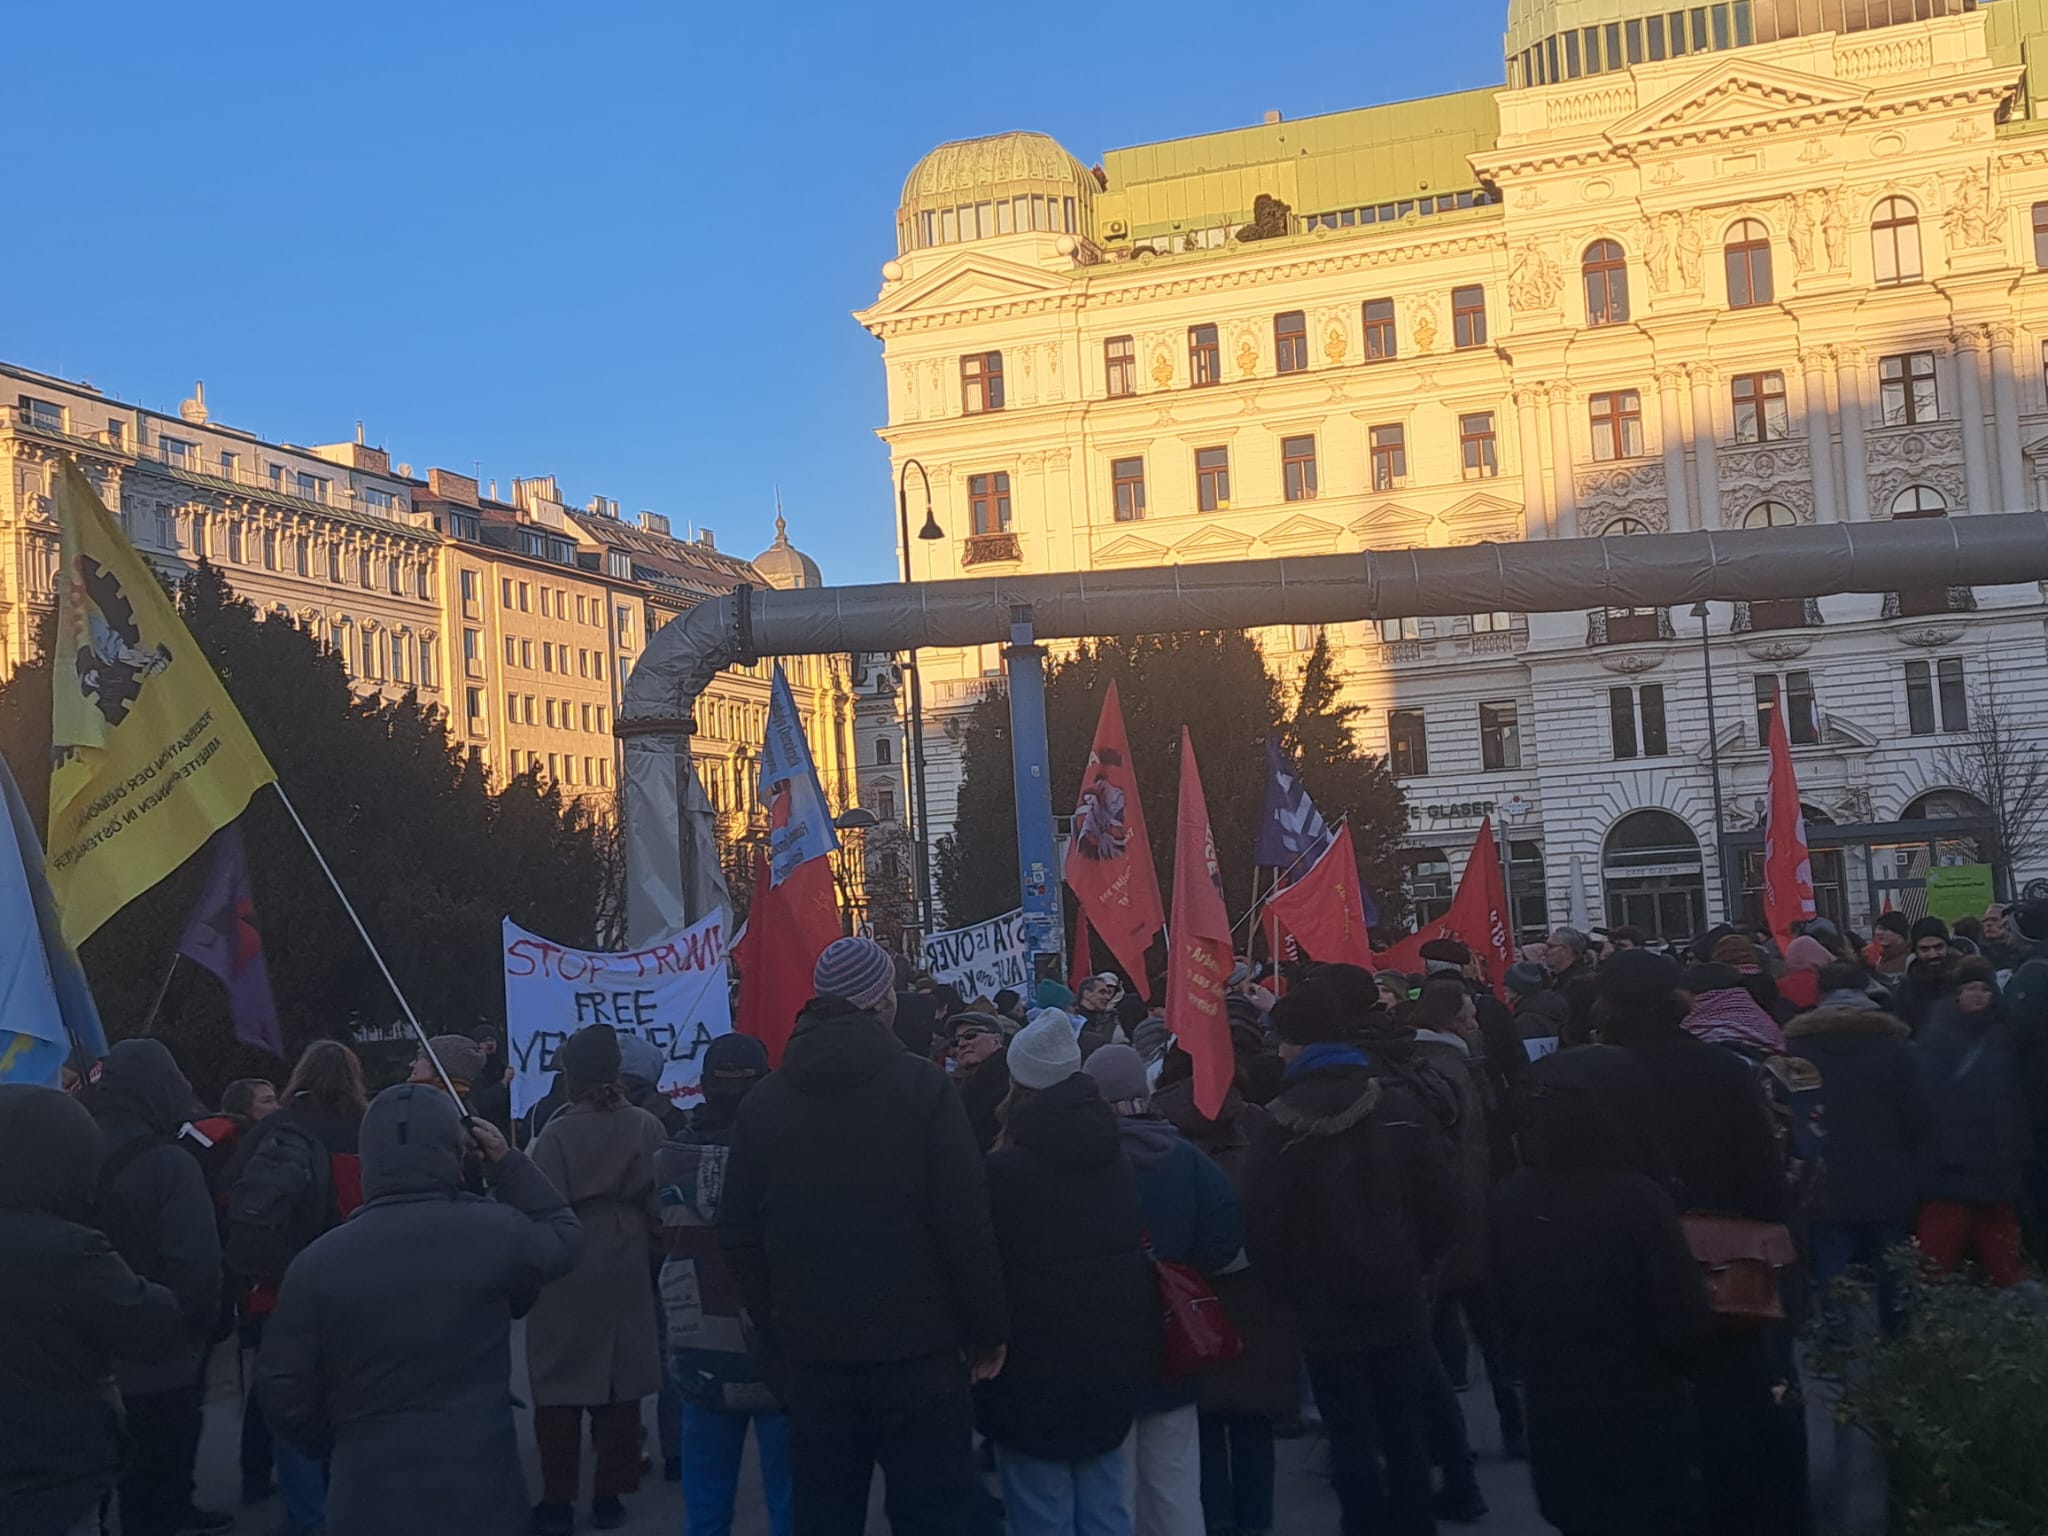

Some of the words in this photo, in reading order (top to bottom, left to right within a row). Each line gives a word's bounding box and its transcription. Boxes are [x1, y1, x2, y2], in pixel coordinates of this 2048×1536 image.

[1427, 799, 1495, 818] GLASER
[507, 937, 609, 984] STOP
[574, 989, 658, 1026] FREE
[511, 1021, 714, 1073] VEELA
